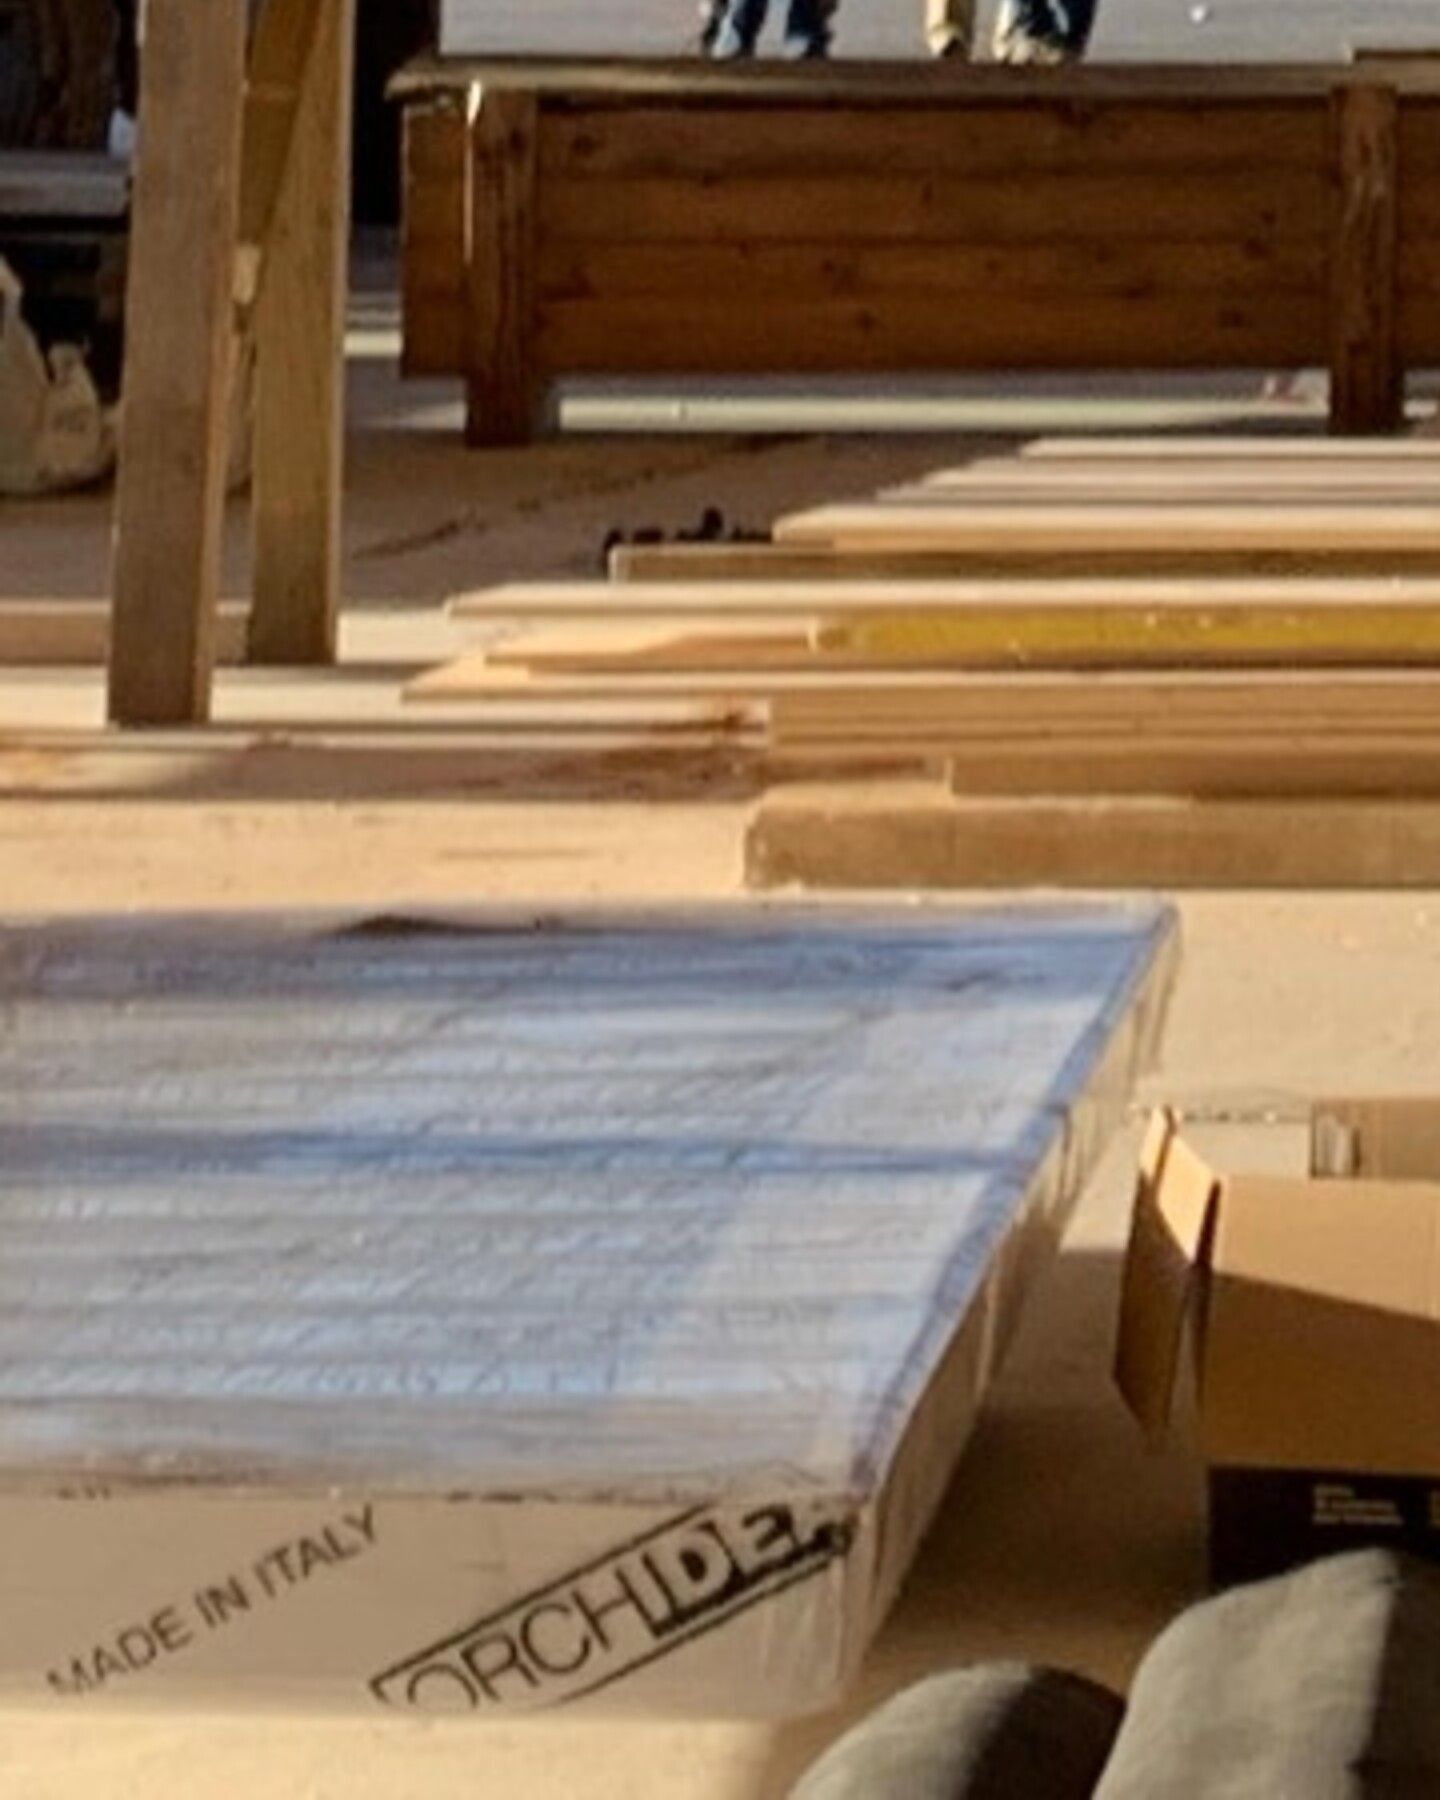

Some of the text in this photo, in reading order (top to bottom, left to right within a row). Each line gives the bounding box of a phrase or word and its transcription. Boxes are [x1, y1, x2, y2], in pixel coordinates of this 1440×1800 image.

[46, 1502, 377, 1695] MADE IN ITALY
